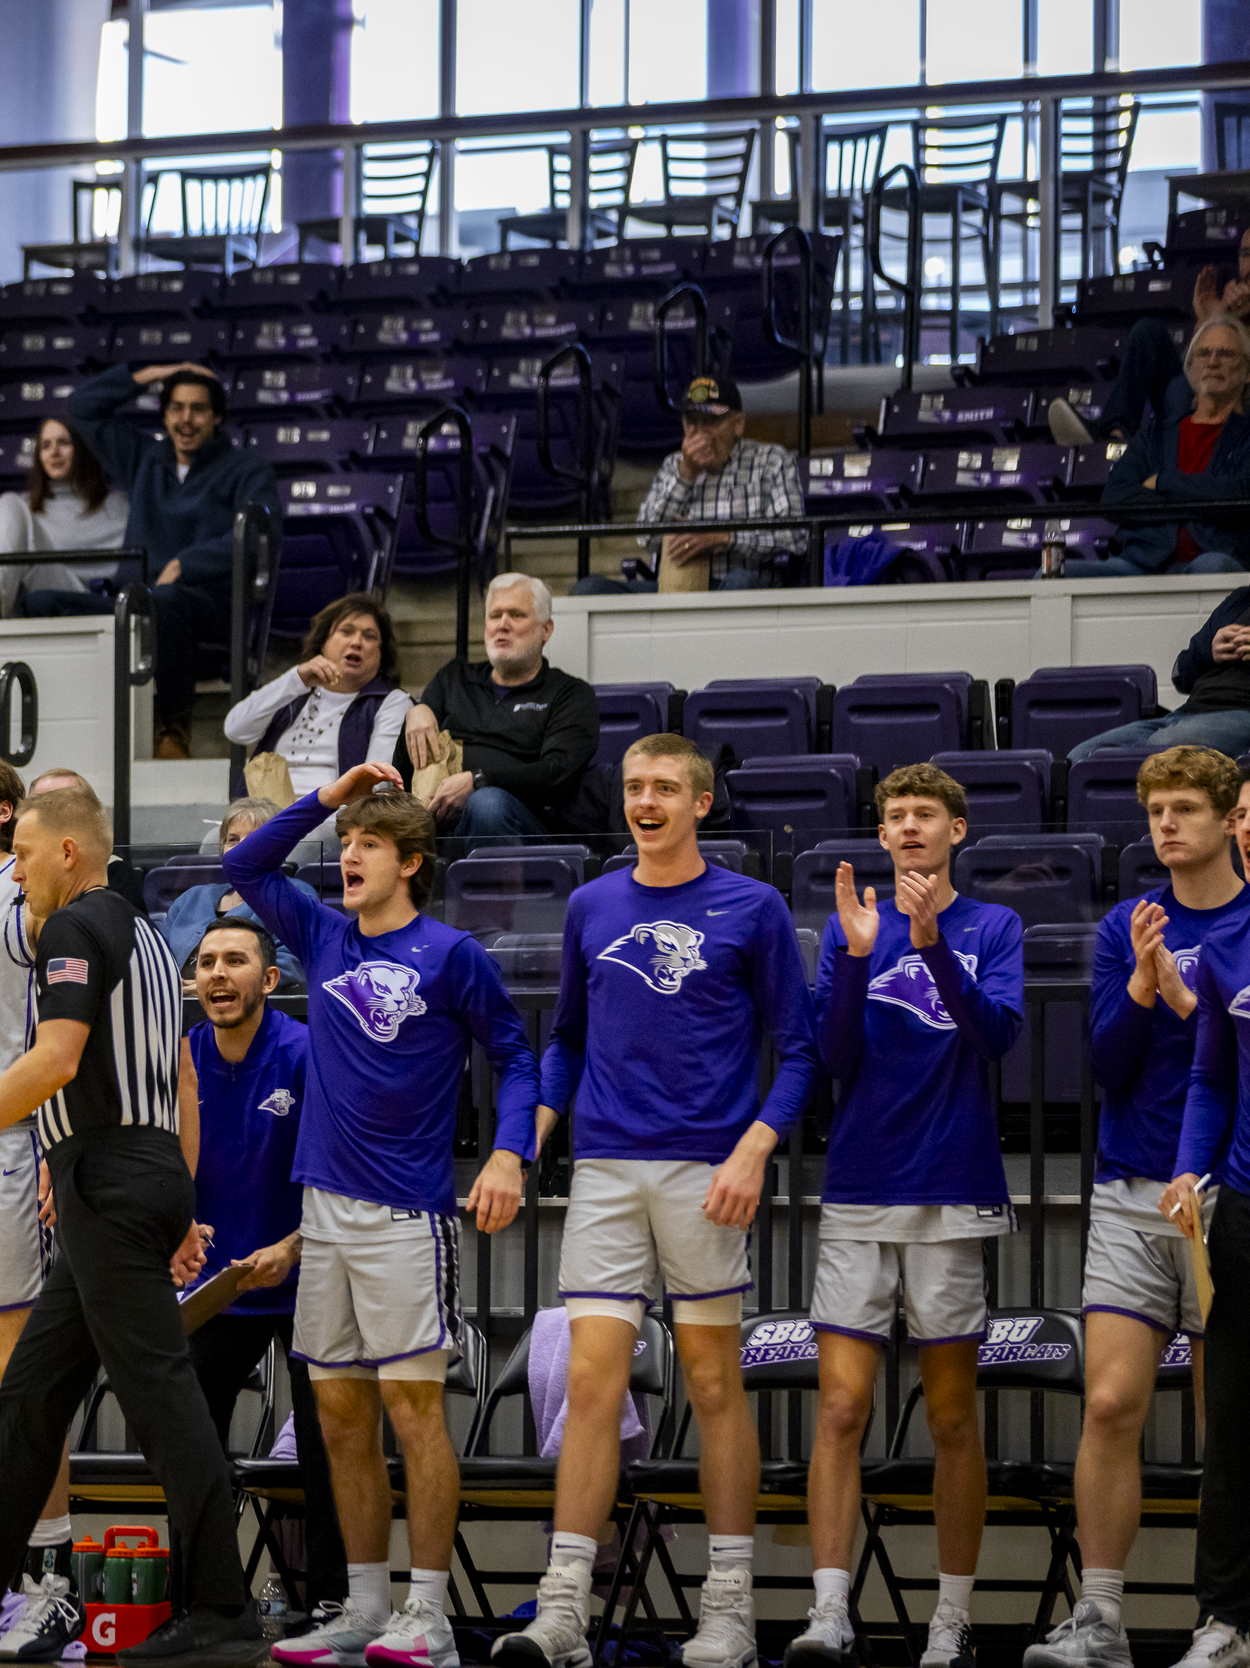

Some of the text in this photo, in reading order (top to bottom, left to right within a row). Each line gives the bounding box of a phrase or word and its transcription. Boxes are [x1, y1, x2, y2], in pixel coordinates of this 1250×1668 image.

[956, 407, 994, 423] SMITH
[983, 1316, 1044, 1346] BU
[976, 1343, 1072, 1366] EARCATS
[92, 1612, 116, 1647] G
